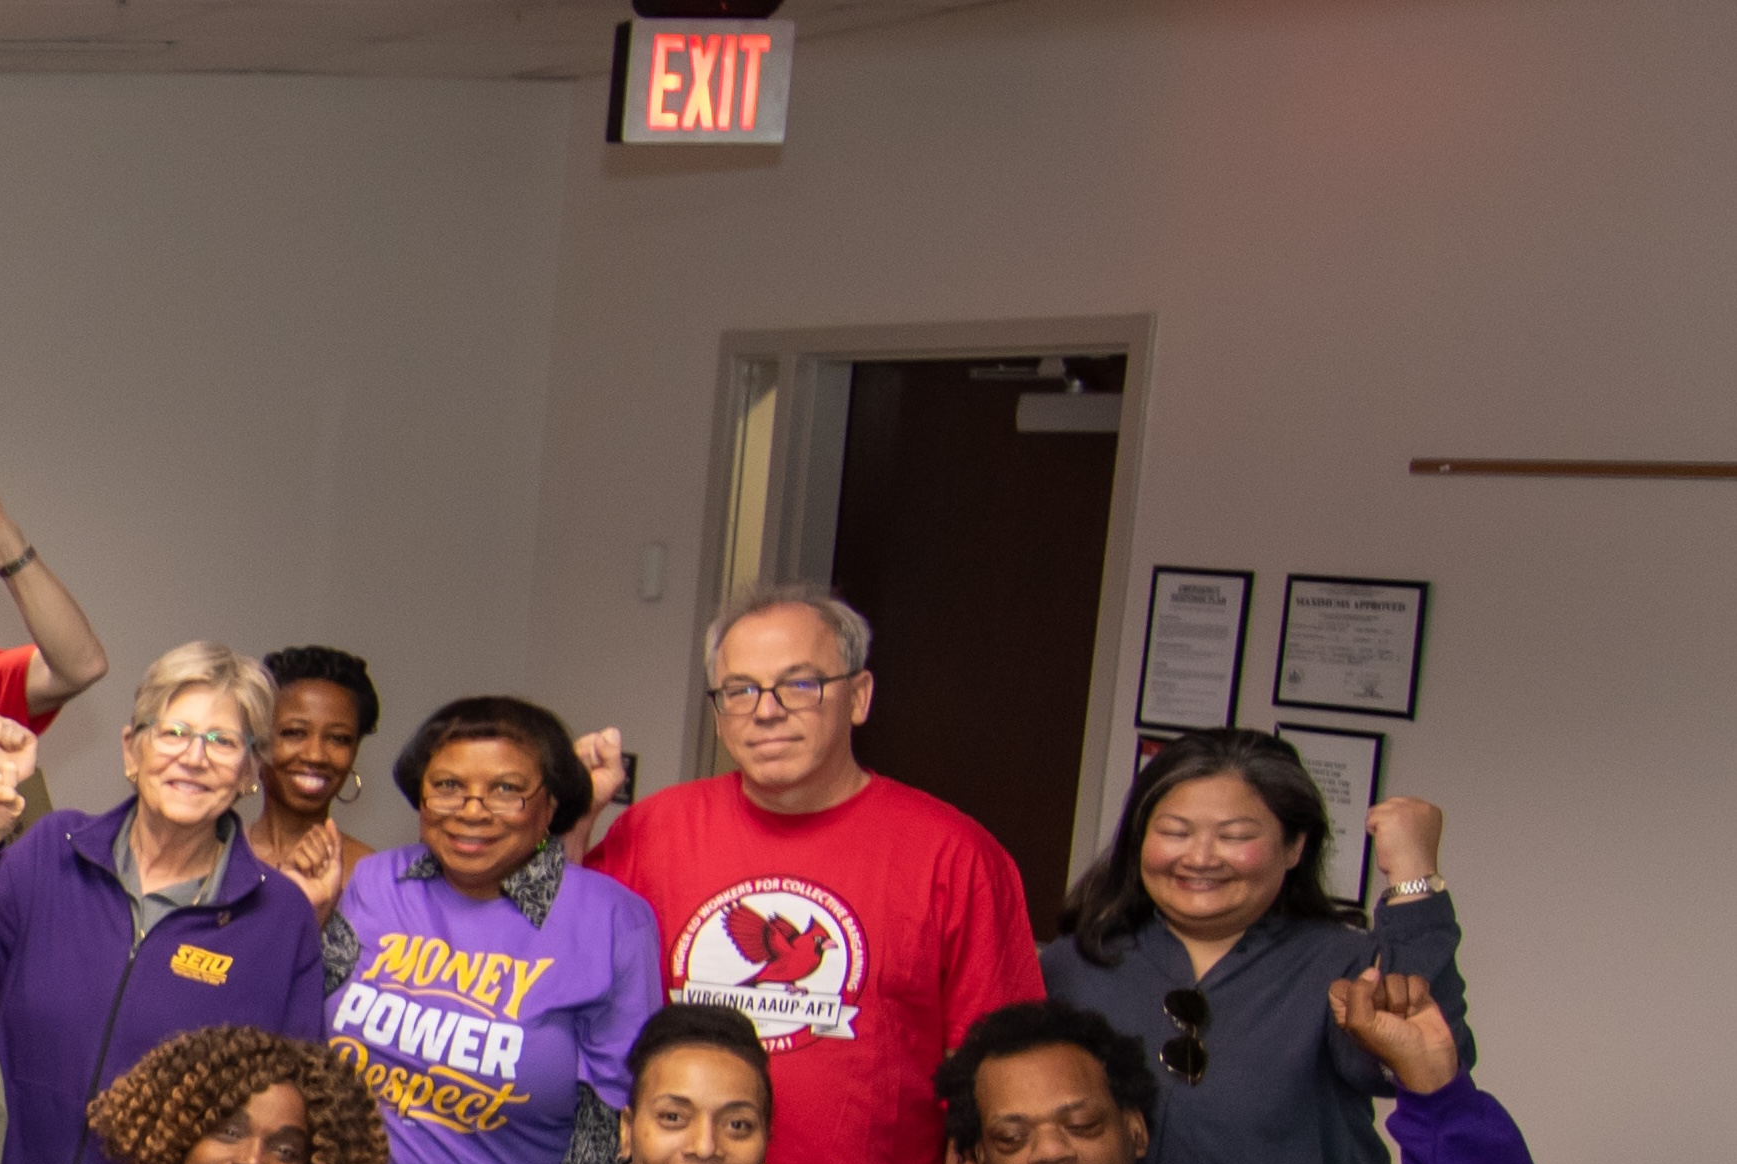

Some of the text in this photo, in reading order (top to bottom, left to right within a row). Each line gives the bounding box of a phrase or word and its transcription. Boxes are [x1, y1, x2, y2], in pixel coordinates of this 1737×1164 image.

[646, 33, 772, 131] EXIT
[700, 880, 753, 919] WORKERS
[755, 878, 780, 893] FOR
[781, 878, 848, 920] COLLECTIVE
[362, 932, 554, 1020] MONEY
[758, 998, 836, 1019] AAUP-AFT
[332, 982, 524, 1079] POWER
